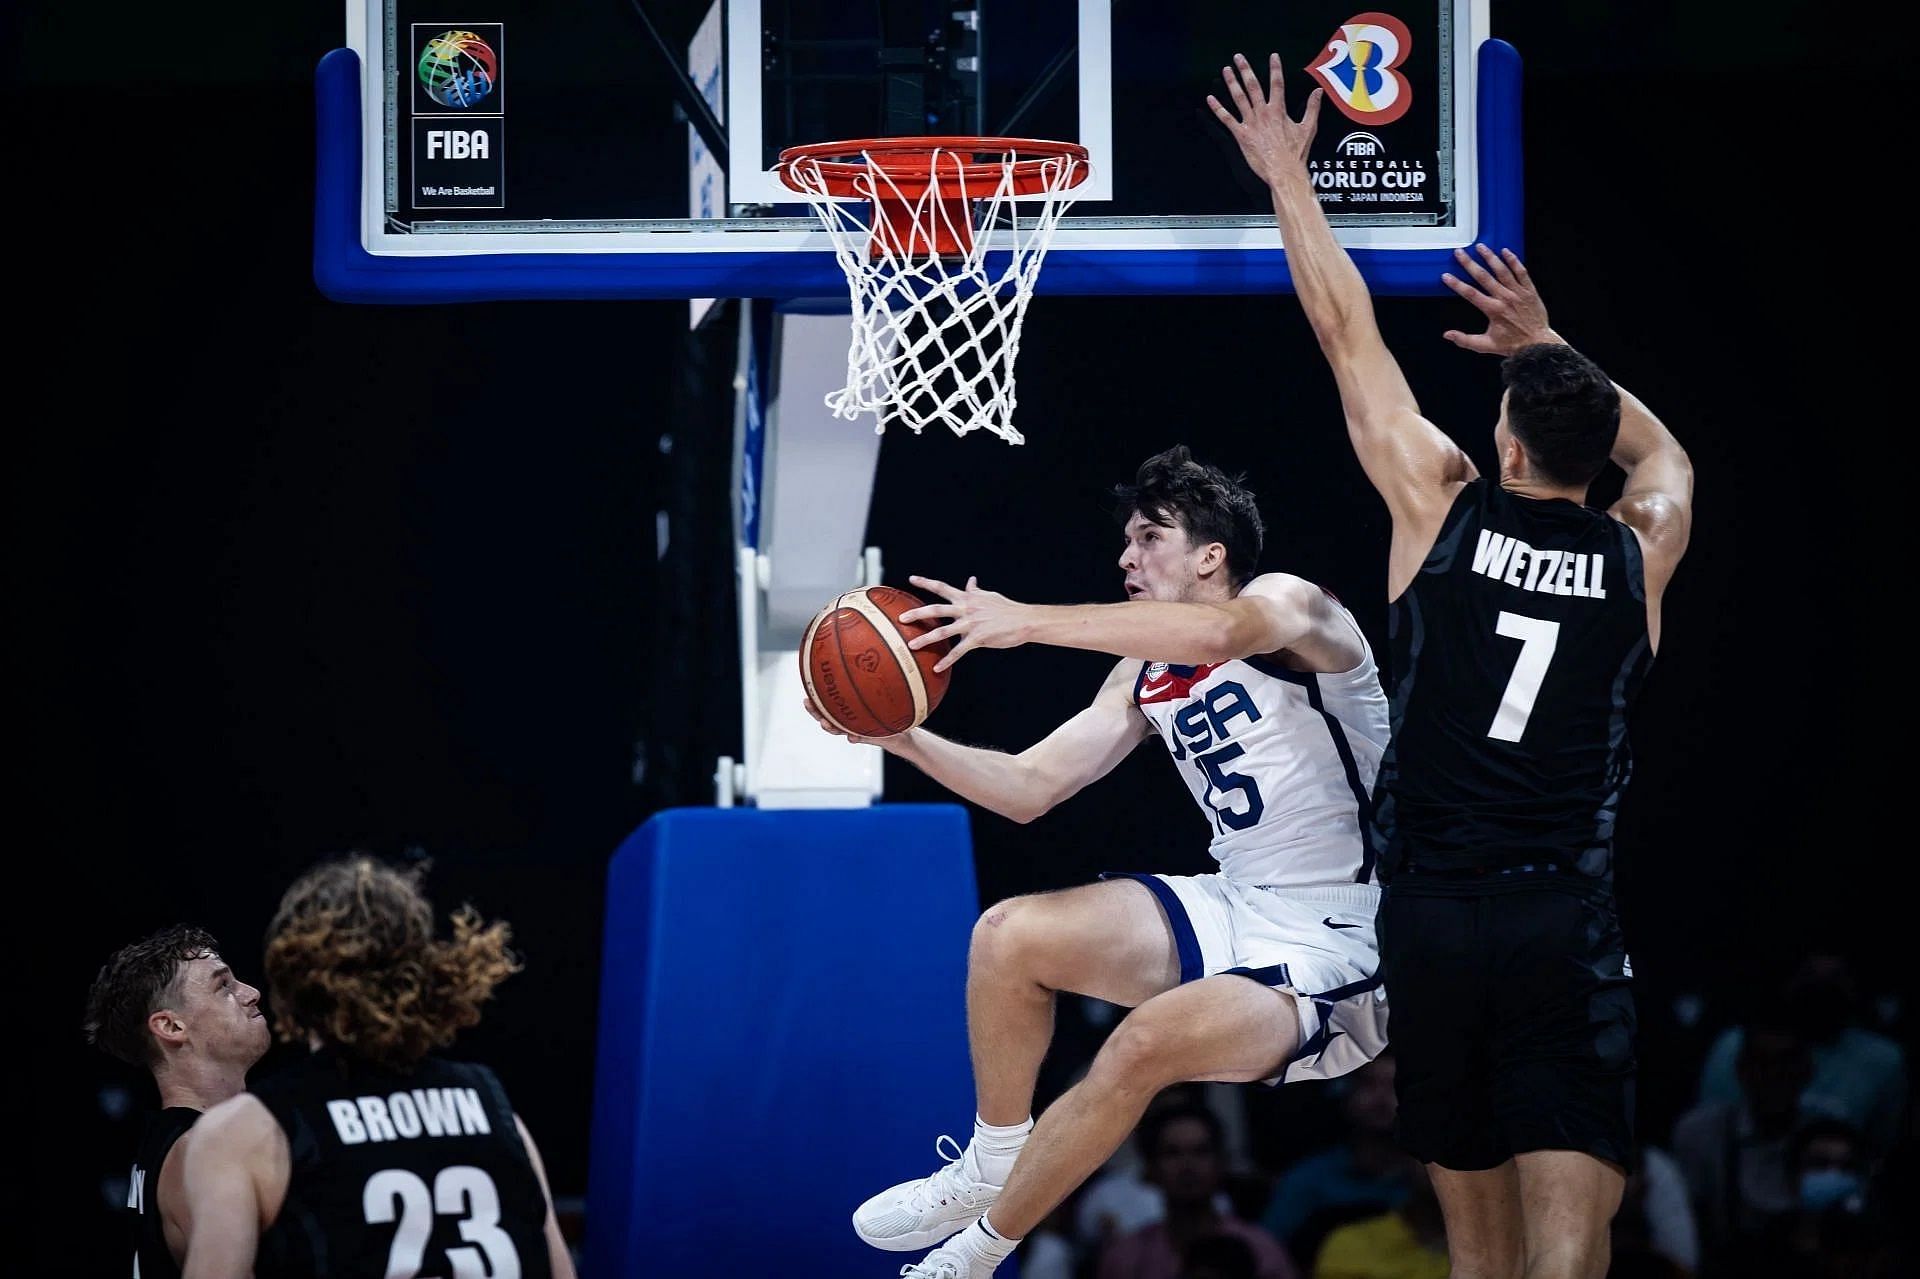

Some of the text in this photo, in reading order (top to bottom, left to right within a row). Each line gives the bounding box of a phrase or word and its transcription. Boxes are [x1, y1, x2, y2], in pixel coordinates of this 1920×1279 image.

[427, 129, 489, 160] FIBA
[1346, 141, 1376, 156] FIBA
[1309, 160, 1424, 169] ASKETBALL
[1381, 171, 1426, 189] CUP
[421, 186, 495, 196] We Are Basketball
[1317, 192, 1343, 202] PPINE
[1380, 192, 1424, 202] INDONESIA
[1471, 528, 1606, 599] WETZELL
[821, 660, 857, 721] molten
[1487, 610, 1561, 743] 7
[327, 1087, 492, 1144] BROWN
[362, 1165, 522, 1279] 23
